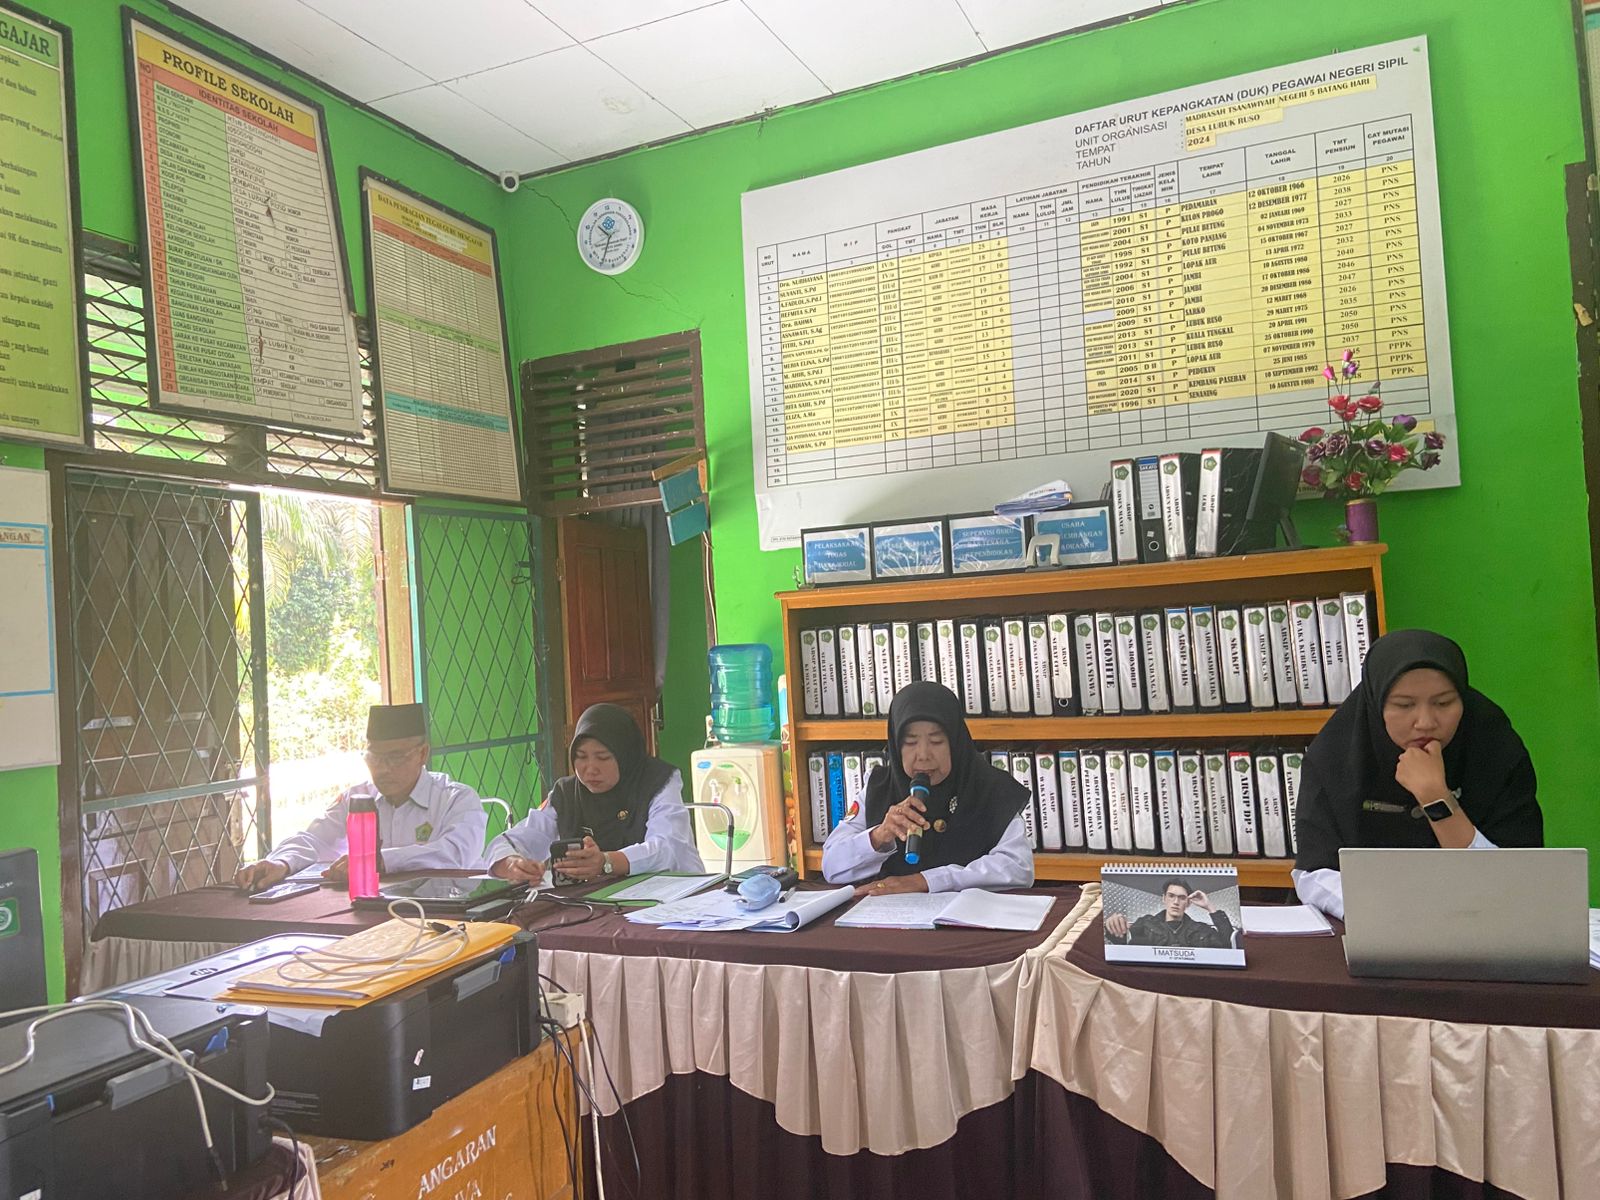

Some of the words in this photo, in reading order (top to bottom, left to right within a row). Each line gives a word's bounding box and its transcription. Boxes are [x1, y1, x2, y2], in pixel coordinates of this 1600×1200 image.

[140, 64, 151, 73] NO
[162, 50, 227, 91] PROFILE
[231, 83, 294, 124] SEKOLAH
[1075, 119, 1116, 135] DAFTAR
[1119, 112, 1149, 125] URUT
[1151, 93, 1233, 118] KEPANGKATAN
[1237, 85, 1269, 104] (DUK)
[1272, 73, 1326, 92] PEGAWAI
[1329, 63, 1374, 80] NEGERI
[1378, 57, 1408, 70] SIPIL
[199, 89, 239, 114] IDENTITAS
[242, 108, 278, 132] SEKOLAH
[1076, 136, 1099, 148] UNIT
[1102, 121, 1168, 141] ORGANISASI
[1186, 109, 1226, 122] MADRASAH
[1228, 98, 1275, 115] TSANAWIYAH
[1279, 91, 1307, 102] NEGERI
[1317, 83, 1348, 94] BATANG
[1351, 79, 1370, 87] HARI
[1076, 143, 1116, 159] TEMPAT
[1186, 126, 1206, 136] DESA
[1208, 119, 1236, 131] LUBUK
[1238, 114, 1260, 126] RUSO
[1373, 135, 1405, 145] PEGAWAI
[1383, 126, 1409, 136] MUTASI
[1076, 156, 1111, 170] TAHUN
[1188, 136, 1210, 146] 2024
[1265, 148, 1296, 159] TANGGAL
[1325, 144, 1355, 154] PENSIUN
[1200, 162, 1224, 172] TEMPAT
[1270, 157, 1291, 165] LAHIR
[1082, 177, 1118, 189] PENDIDIKAN
[1120, 171, 1151, 182] TERAKHIR
[1202, 170, 1221, 179] LAHIR
[1257, 185, 1287, 196] OKTOBER
[1381, 165, 1398, 173] PNS
[1016, 192, 1040, 202] LATIHAN
[1042, 188, 1067, 198] JABATAN
[1086, 197, 1102, 205] NAMA
[1335, 199, 1351, 207] 2027
[1383, 190, 1399, 198] PNS
[1013, 211, 1029, 219] NAMA
[1113, 215, 1131, 224] 1991
[1258, 196, 1290, 208] DESEMBER
[1113, 239, 1131, 247] 2004
[1389, 341, 1412, 350] PPPK
[1390, 354, 1413, 362] PPPK
[1391, 367, 1414, 375] PPPK
[1296, 620, 1304, 642] WAKA
[1178, 633, 1186, 661] ARSIP
[1204, 631, 1212, 654] ARSIP
[1280, 626, 1288, 650] ARSIP
[1284, 652, 1290, 662] SK
[1309, 642, 1317, 664] ARSIP
[1085, 643, 1093, 667] DATA
[1104, 639, 1115, 688] KOMITE
[1230, 638, 1240, 676] SKAKPT
[1088, 669, 1096, 697] SISWA
[1207, 656, 1217, 700] SIMPATIKA
[1240, 775, 1249, 807] ARSIP
[1243, 810, 1251, 825] DP
[418, 1125, 496, 1200] ANGARAN
